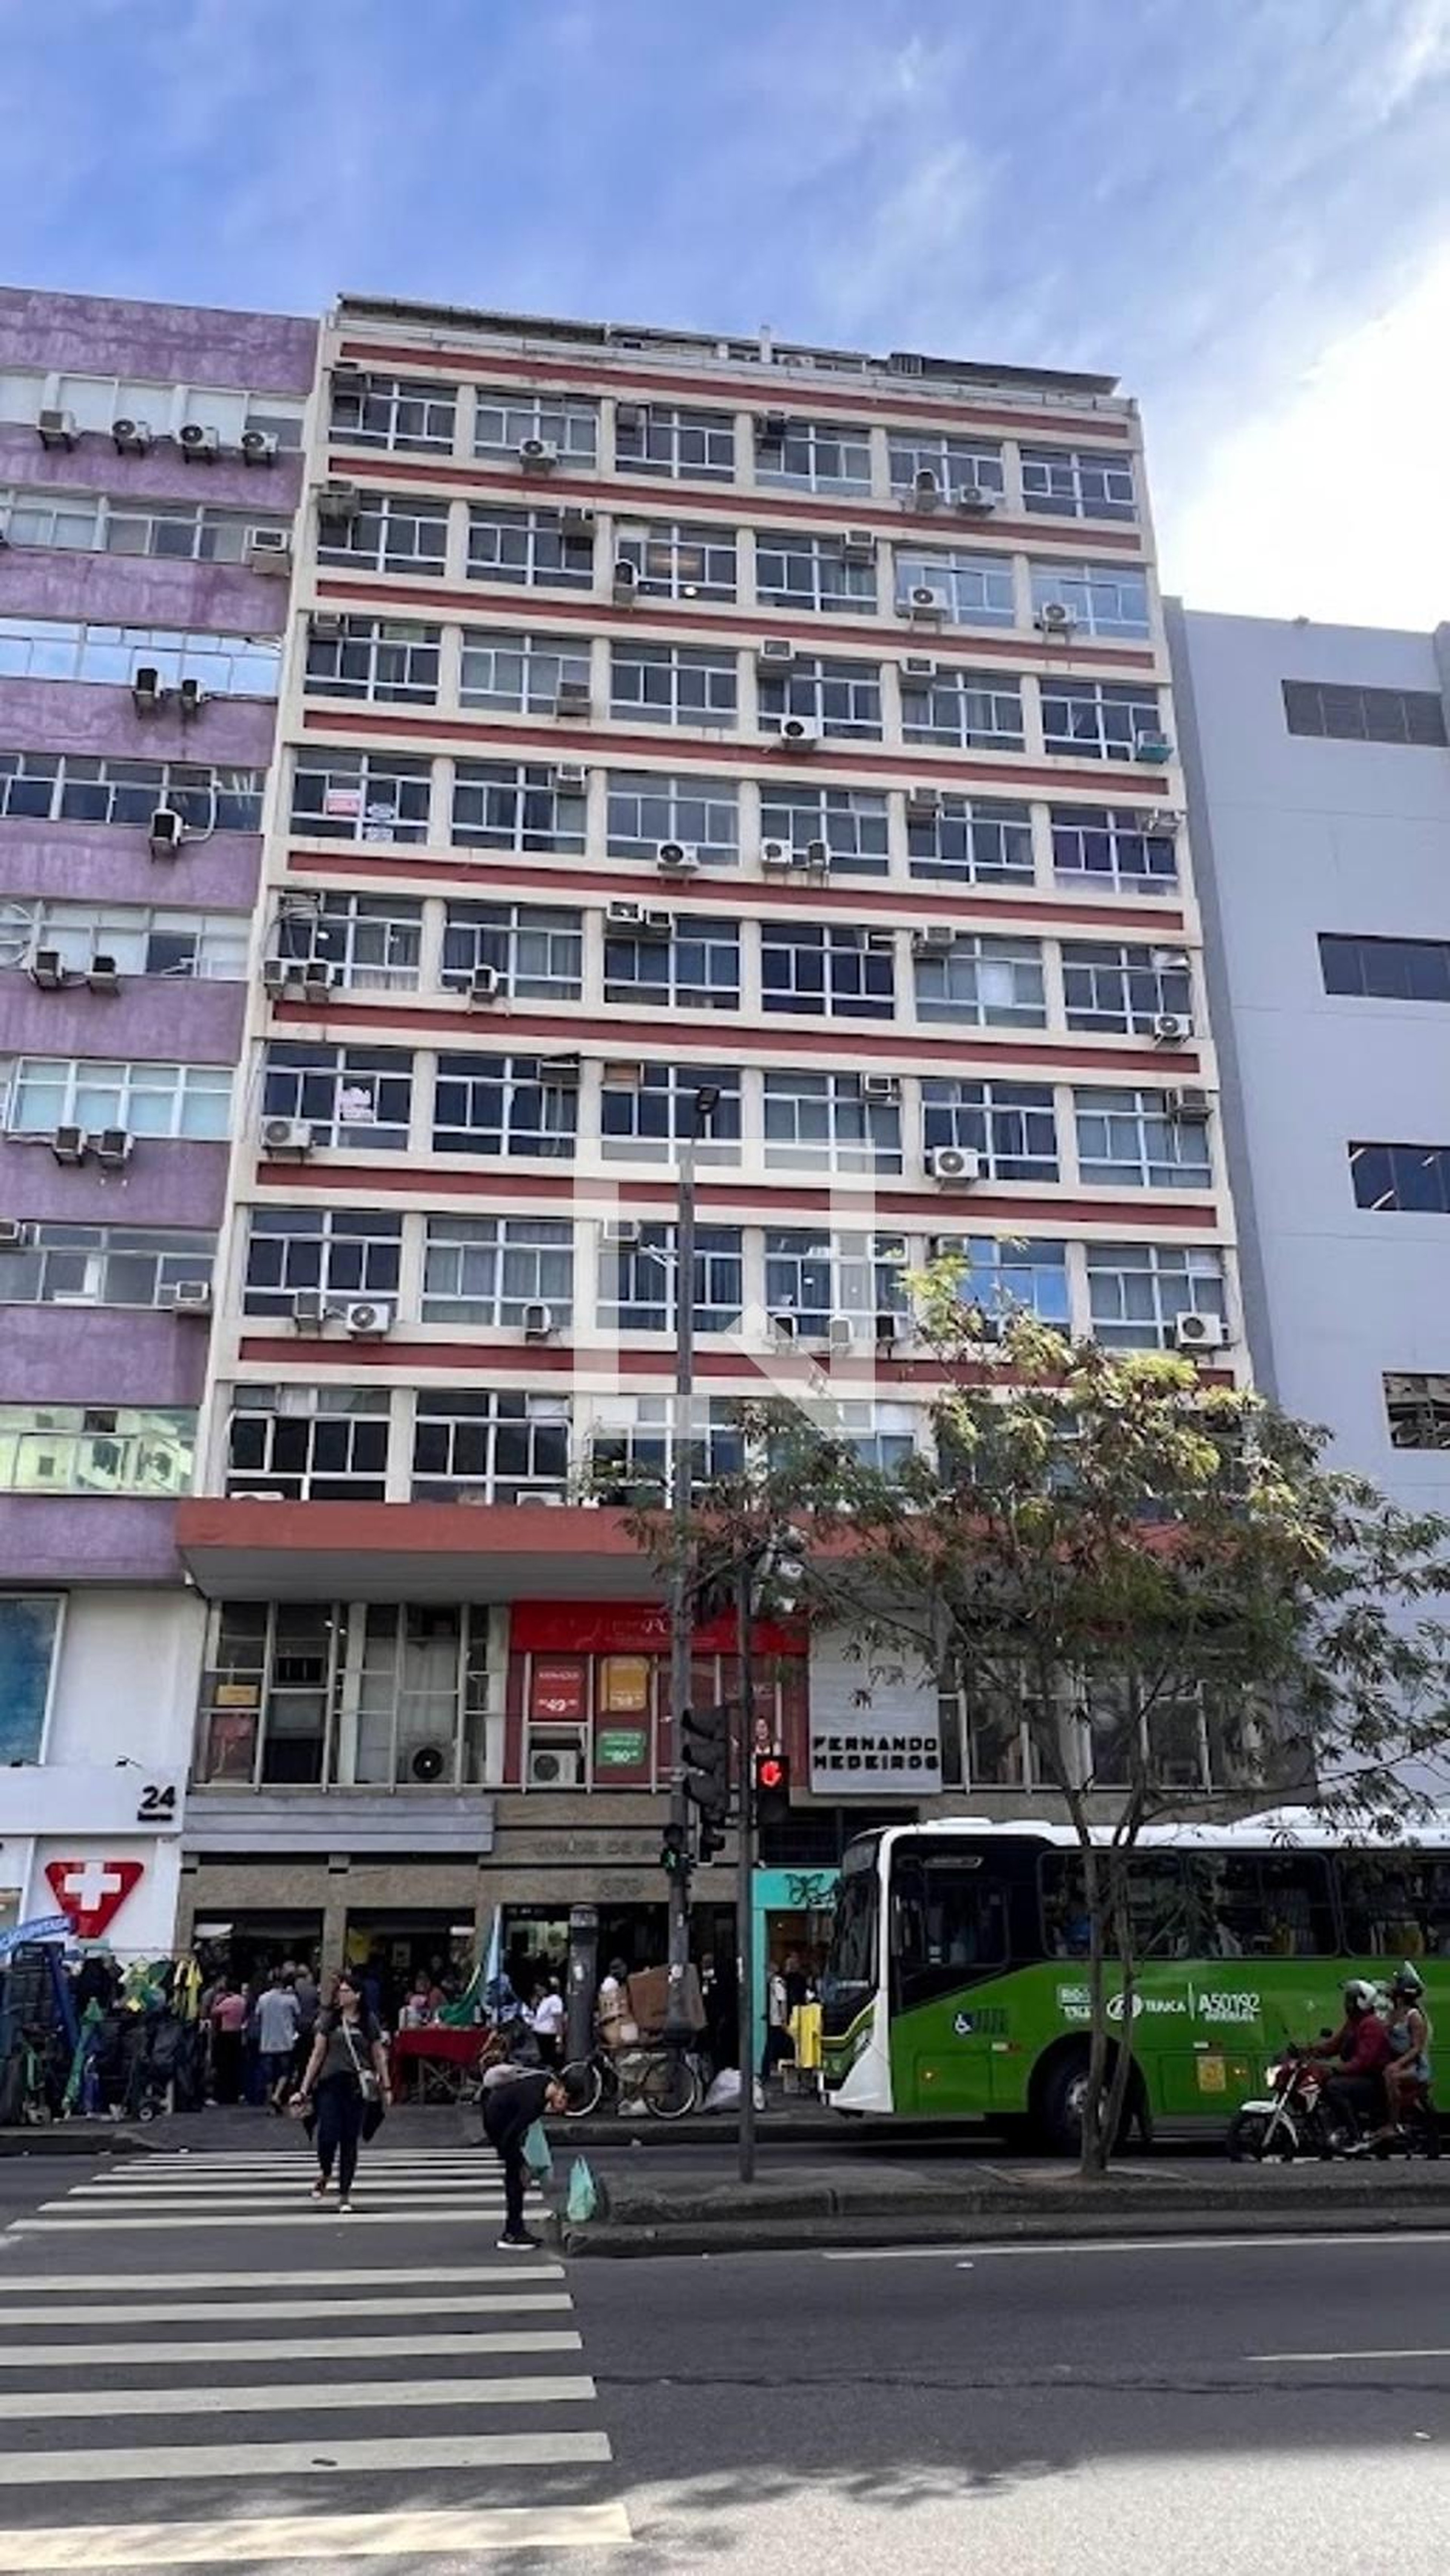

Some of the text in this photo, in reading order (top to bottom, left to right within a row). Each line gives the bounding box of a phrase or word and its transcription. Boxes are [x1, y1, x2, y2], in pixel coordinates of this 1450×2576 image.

[814, 1736, 937, 1750] FERNANDO
[814, 1755, 938, 1770] MEDEIROS
[141, 1786, 175, 1809] 24
